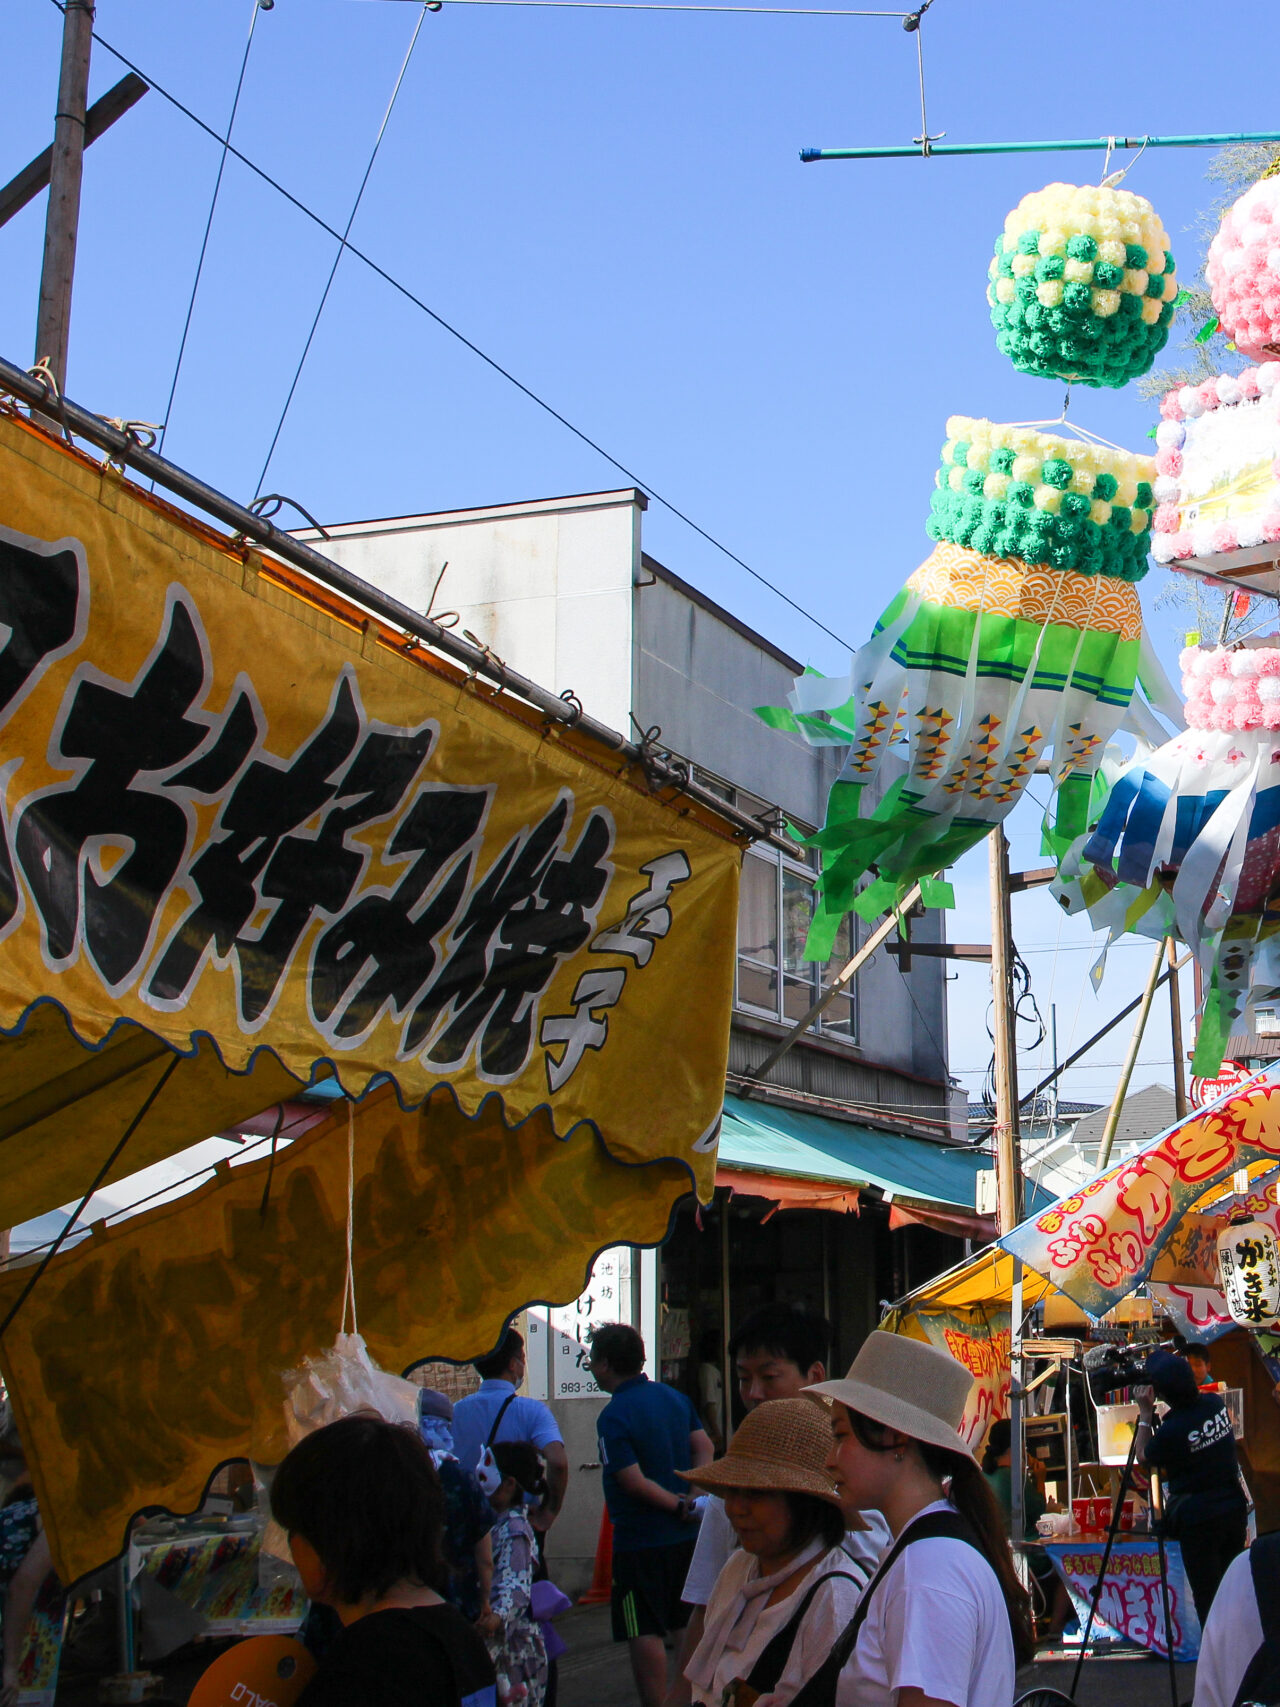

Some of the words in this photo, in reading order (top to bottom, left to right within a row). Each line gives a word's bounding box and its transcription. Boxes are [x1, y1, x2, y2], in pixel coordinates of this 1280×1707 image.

[1235, 1237, 1278, 1323] かき氷
[560, 1381, 600, 1394] 963-32
